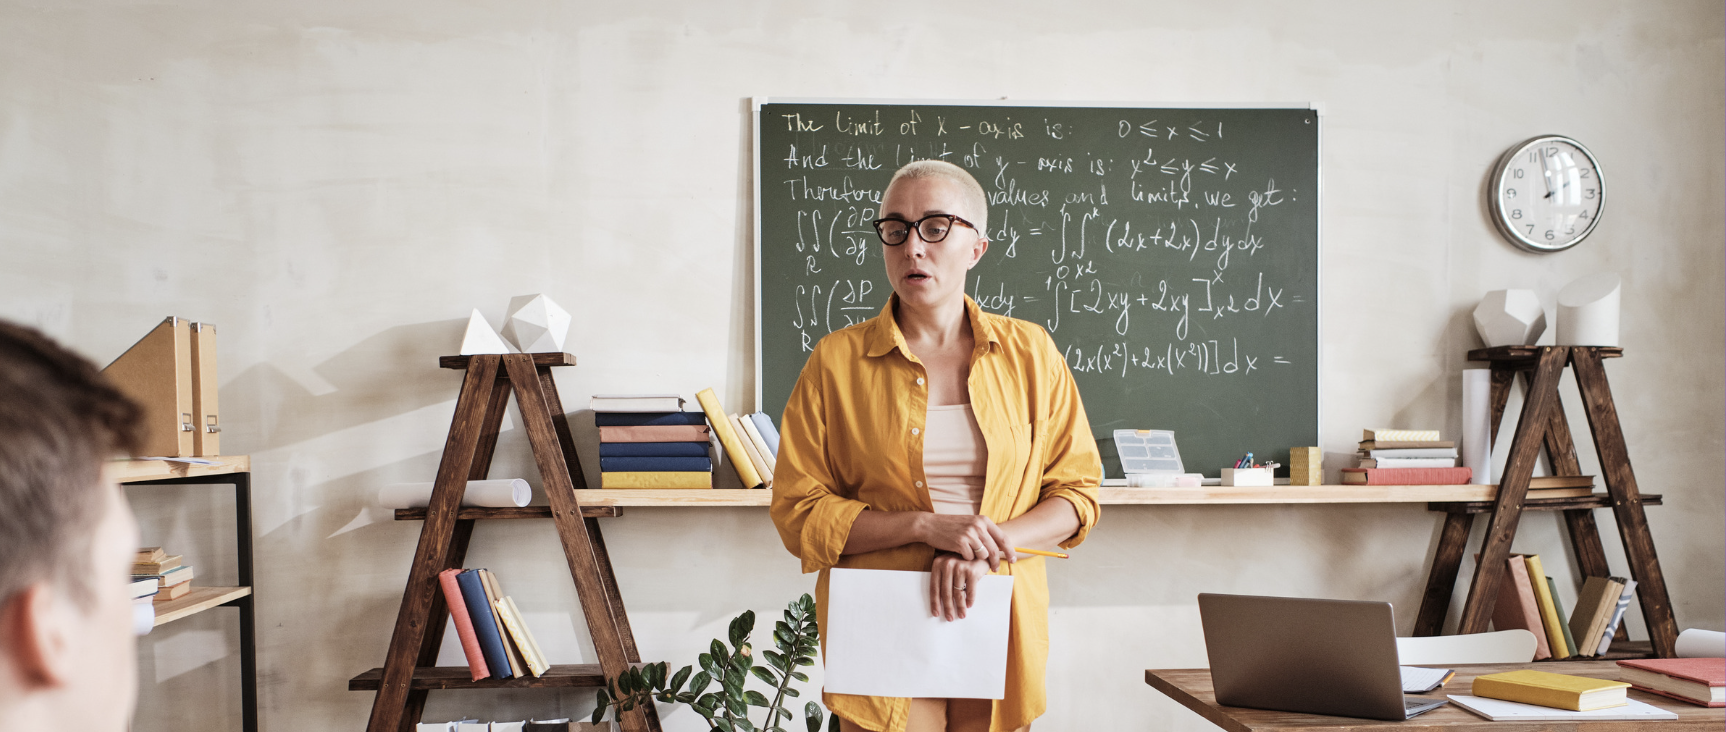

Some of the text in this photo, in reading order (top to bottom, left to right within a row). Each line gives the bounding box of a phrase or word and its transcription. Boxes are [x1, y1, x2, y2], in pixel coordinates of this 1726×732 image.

[782, 113, 824, 132] The
[900, 110, 922, 136] of
[784, 144, 828, 170] And
[842, 142, 882, 170] the
[897, 143, 952, 169] lit
[964, 142, 986, 168] of
[1529, 152, 1536, 163] 11
[1546, 147, 1559, 158] 12
[1514, 169, 1524, 179] 10
[1580, 168, 1590, 178] 2
[987, 179, 1049, 208] values
[1065, 179, 1107, 205] and
[1205, 191, 1236, 207] we
[1506, 188, 1516, 199] 9
[1585, 189, 1595, 199] 3
[1512, 209, 1522, 219] 8
[1579, 210, 1588, 220] 4
[1526, 224, 1534, 234] 7
[1545, 230, 1554, 240] 6
